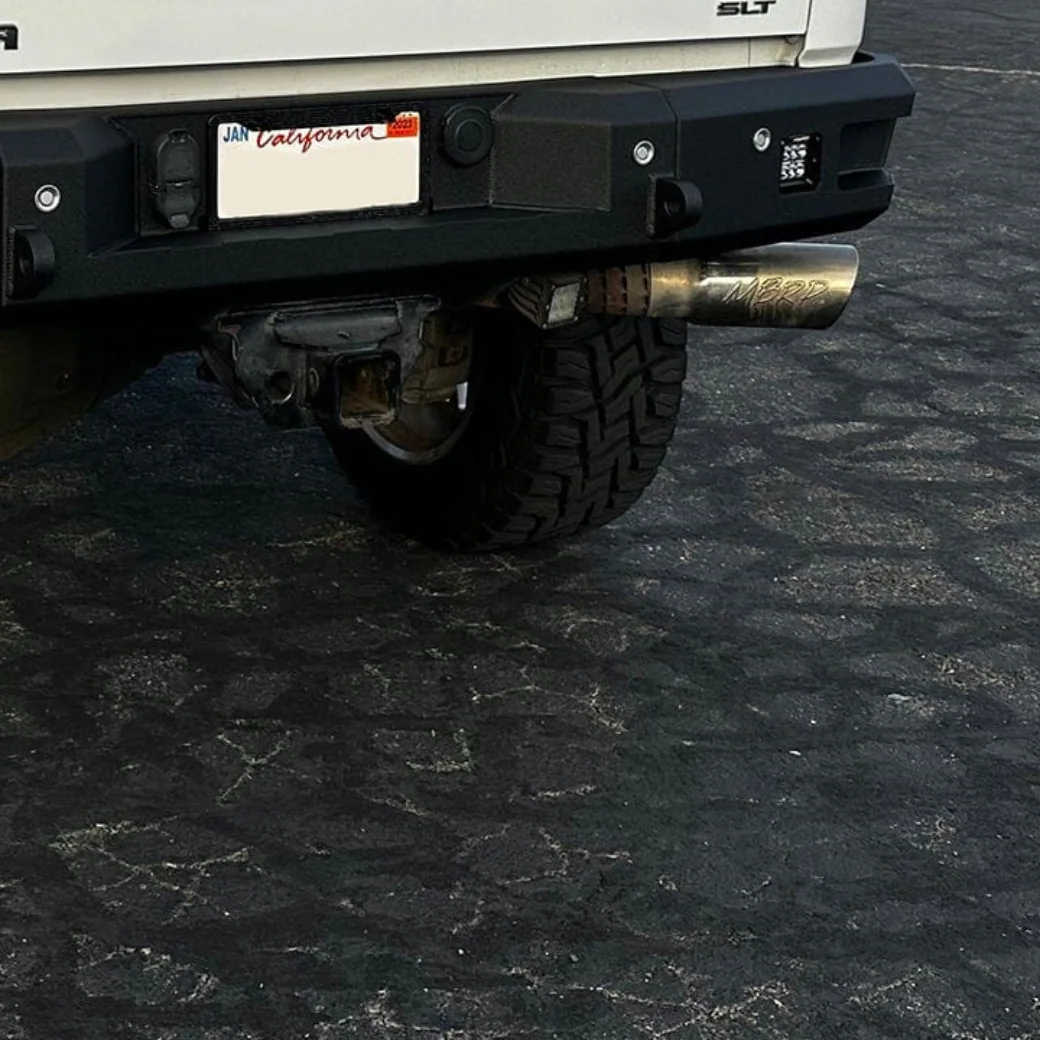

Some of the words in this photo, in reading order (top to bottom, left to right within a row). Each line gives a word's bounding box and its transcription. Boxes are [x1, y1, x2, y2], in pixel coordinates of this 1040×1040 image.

[717, 0, 777, 16] SLT
[222, 125, 250, 143] JAN
[256, 125, 388, 153] California
[721, 277, 830, 307] MBRP
